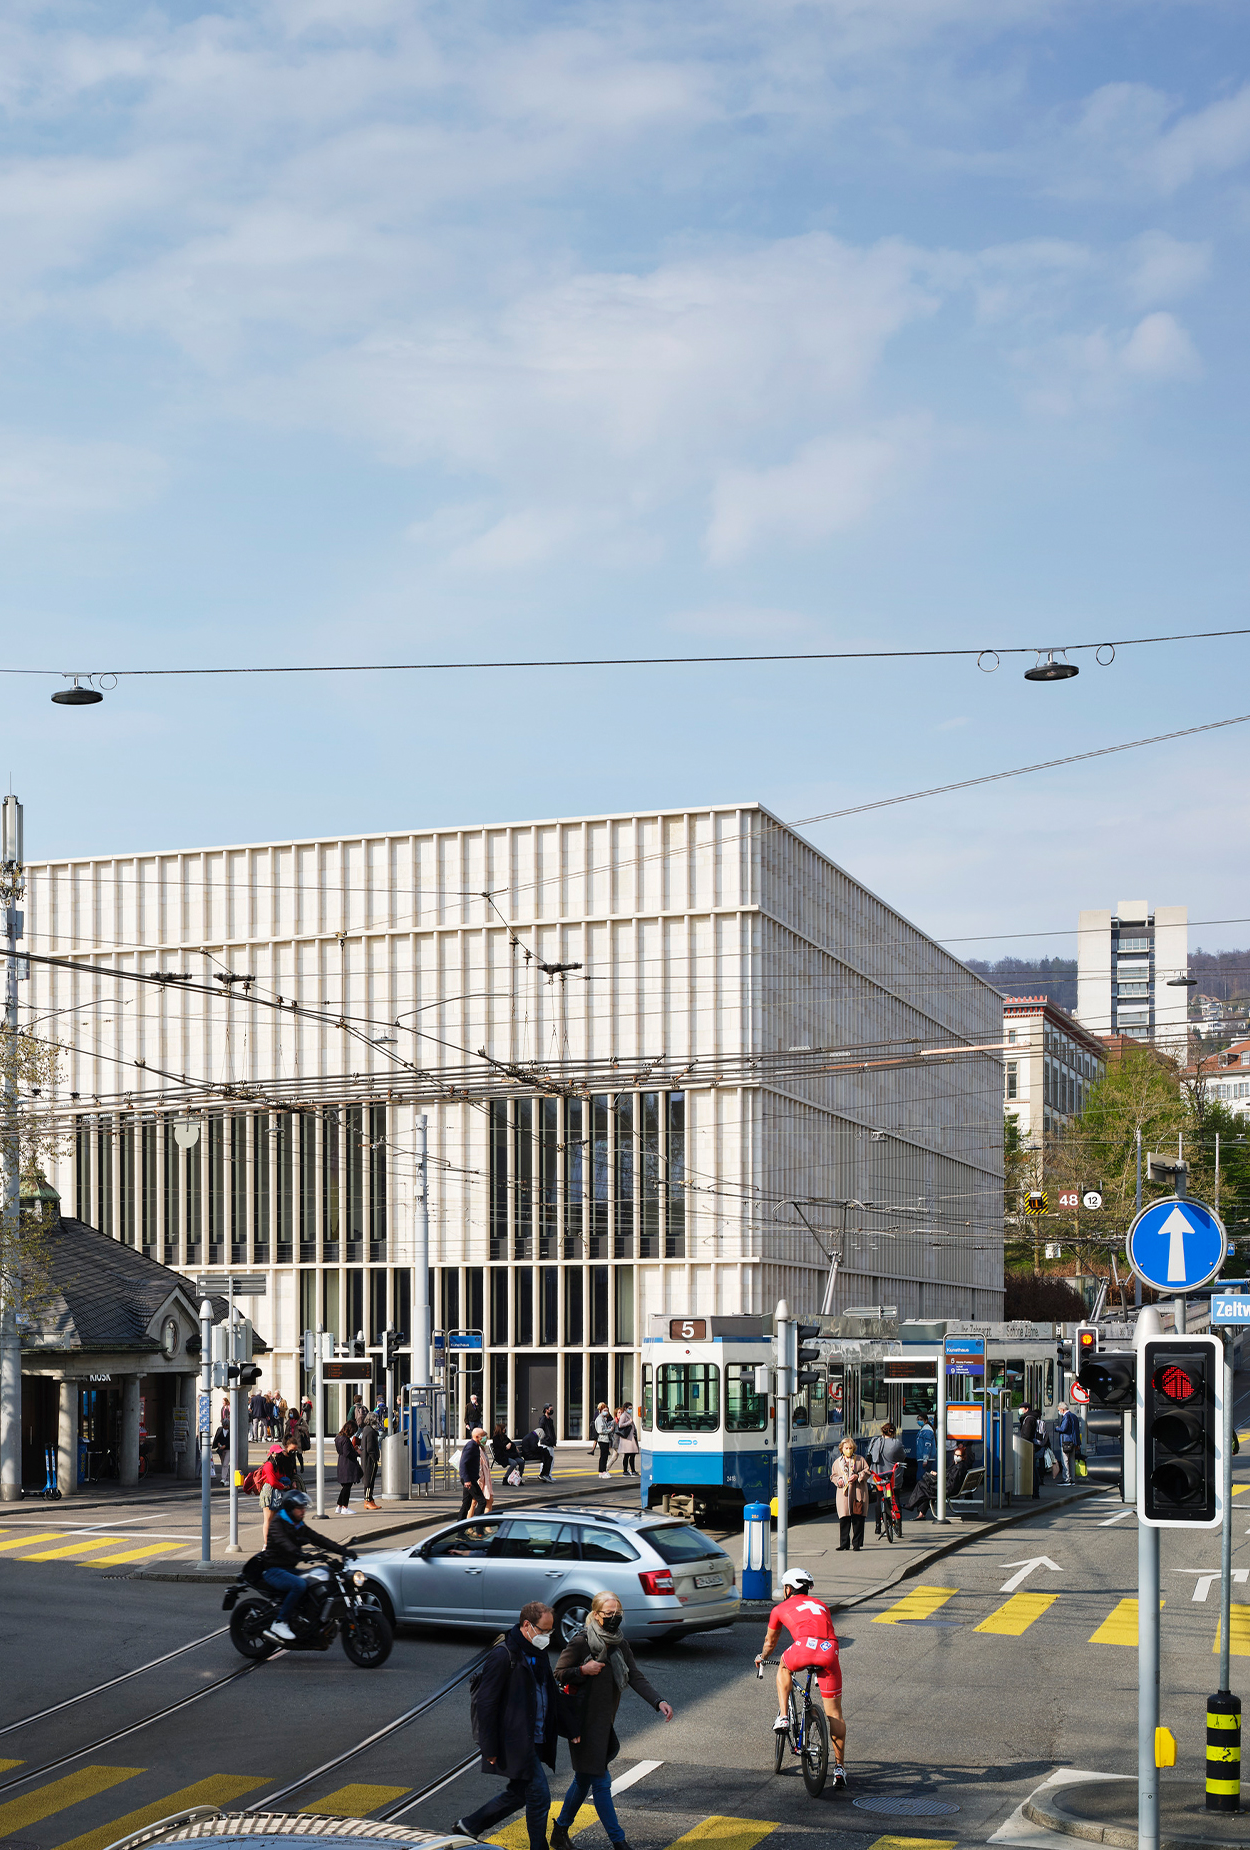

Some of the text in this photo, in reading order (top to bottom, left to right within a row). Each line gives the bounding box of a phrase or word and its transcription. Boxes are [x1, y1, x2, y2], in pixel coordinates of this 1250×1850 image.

[1059, 1194, 1078, 1206] 48
[1088, 1196, 1098, 1204] 12
[1216, 1301, 1250, 1317] Zeltw
[681, 1321, 695, 1338] 5
